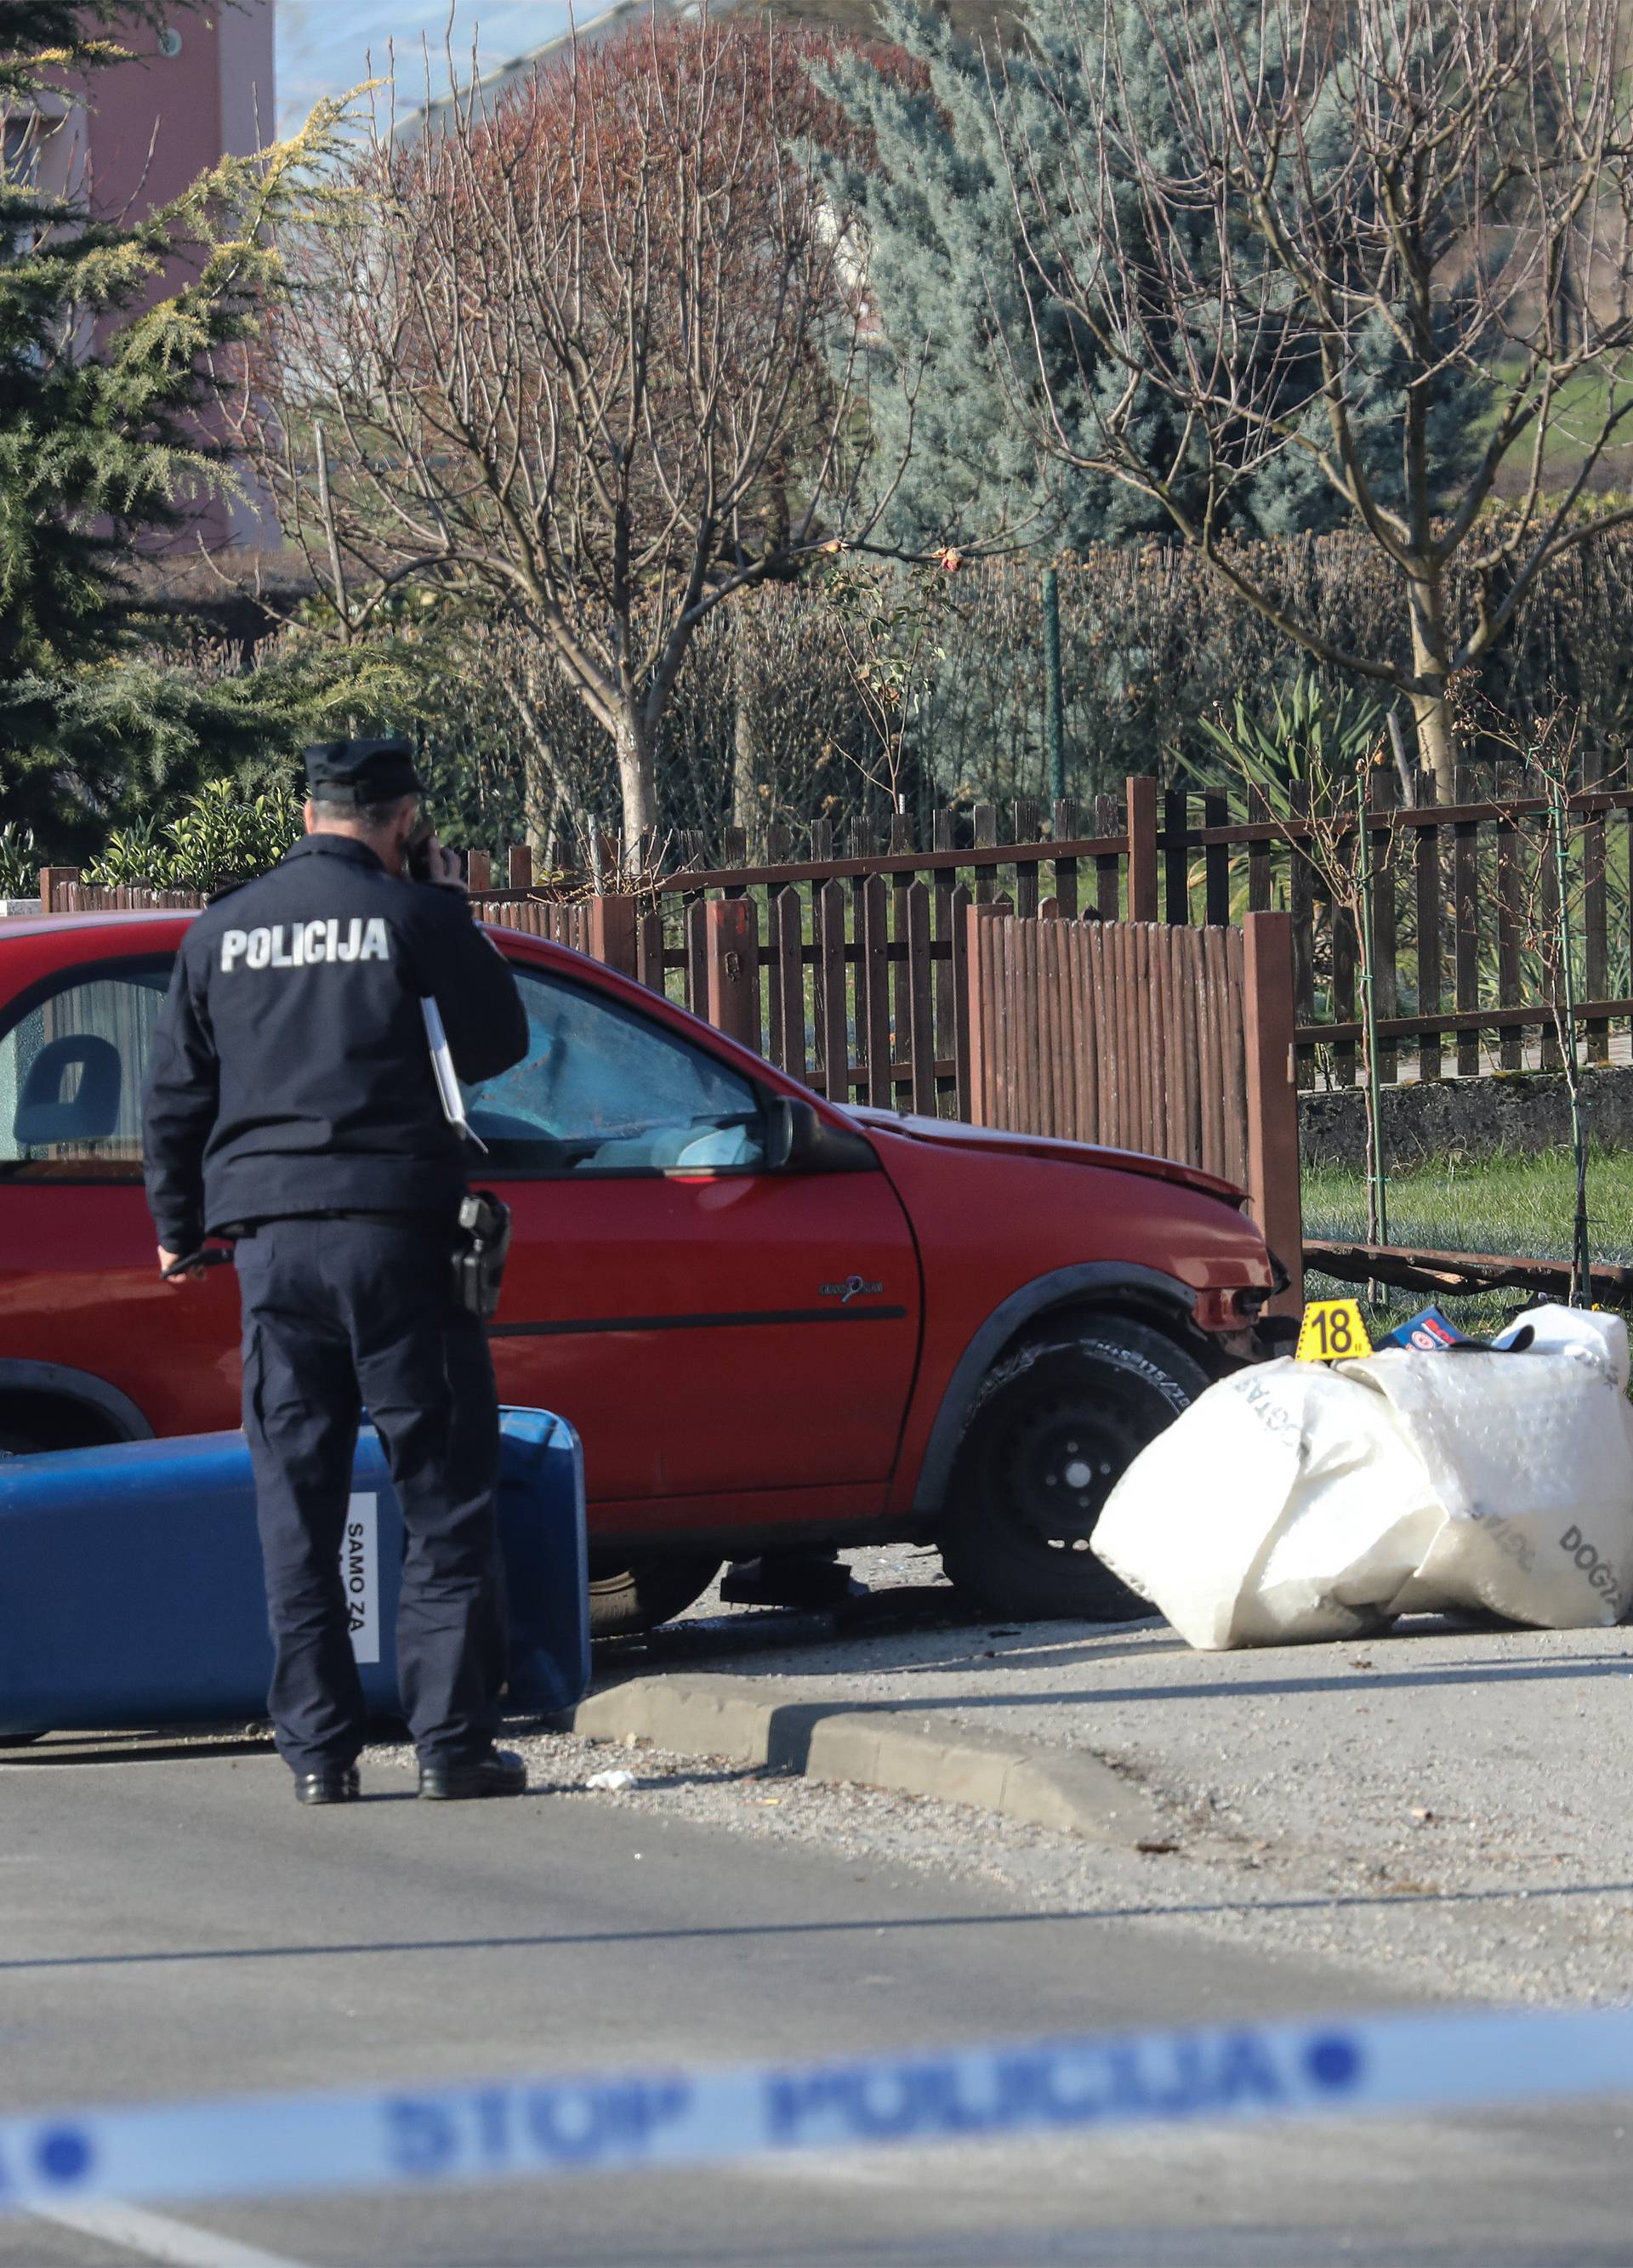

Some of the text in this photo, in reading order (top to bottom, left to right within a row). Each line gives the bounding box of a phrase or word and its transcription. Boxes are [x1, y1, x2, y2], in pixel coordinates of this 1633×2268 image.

[221, 918, 390, 972] POLICIJA
[1312, 1308, 1351, 1354] 18
[349, 1523, 364, 1631] SAMO ZA
[390, 2034, 1284, 2174] STOP POLICIJA
